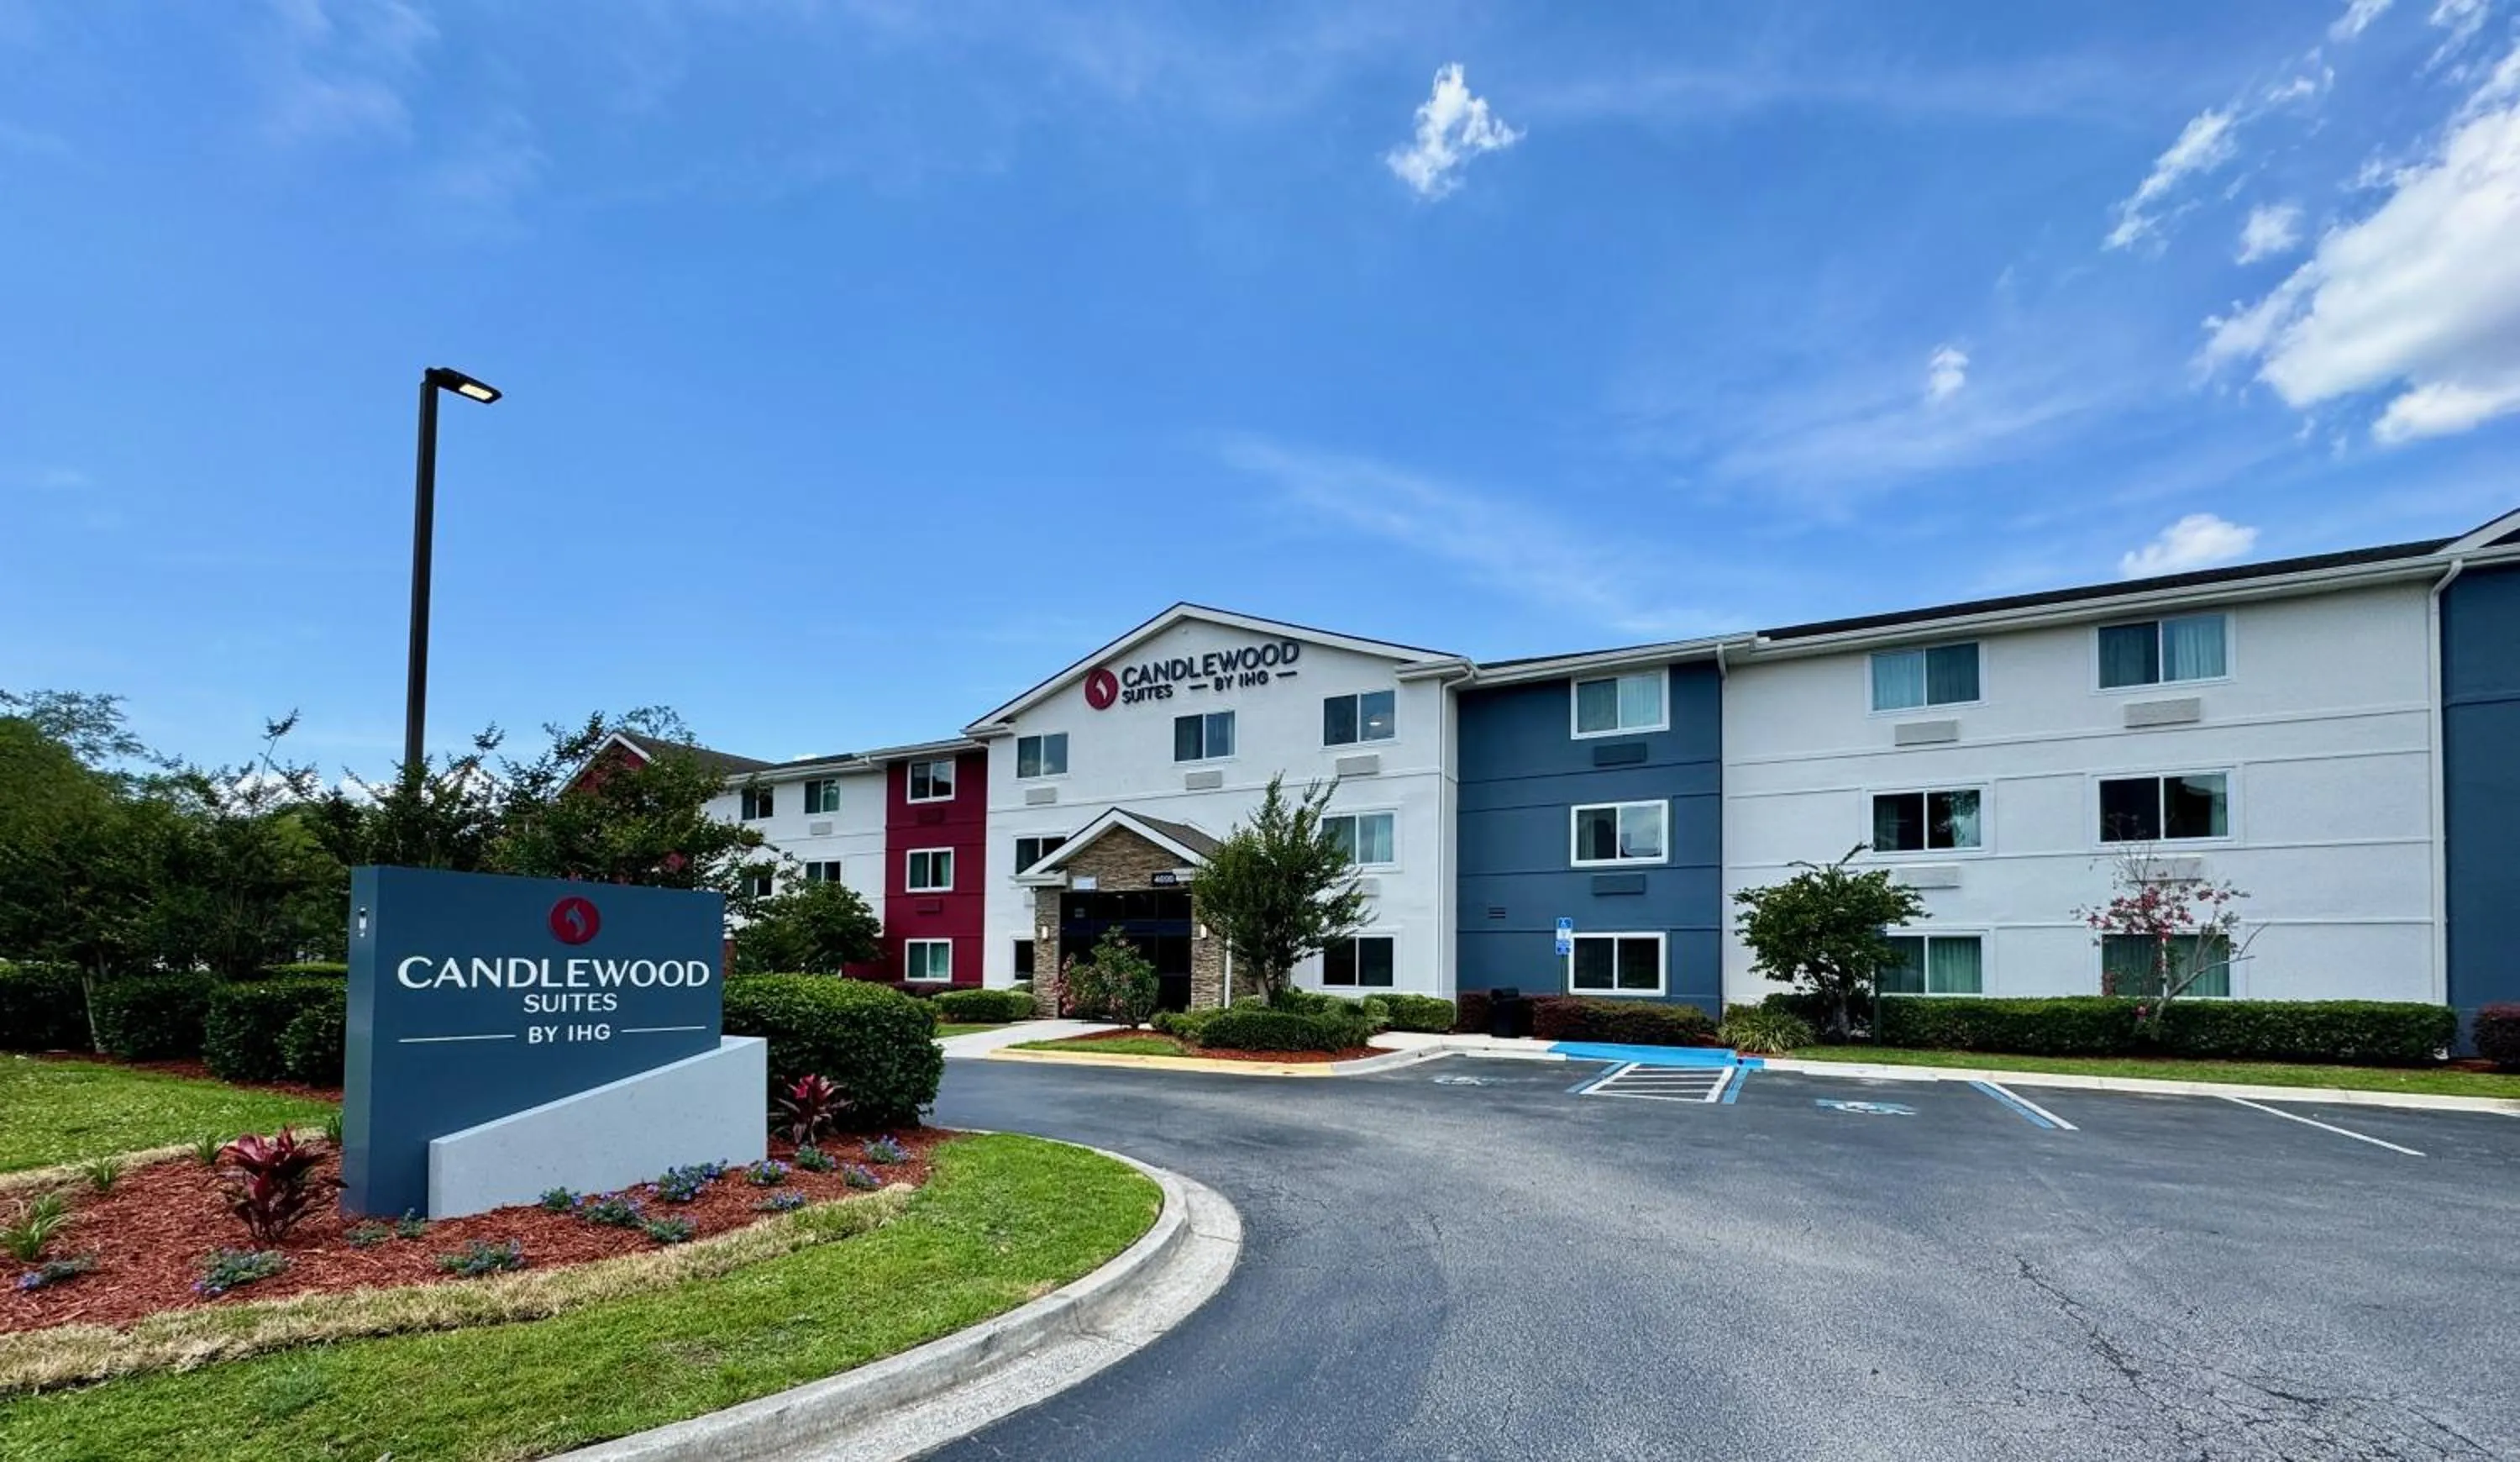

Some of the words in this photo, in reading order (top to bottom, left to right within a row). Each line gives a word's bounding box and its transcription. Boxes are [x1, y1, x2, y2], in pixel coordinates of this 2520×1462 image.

[1121, 641, 1300, 688] CANDLEWOOD
[1121, 684, 1173, 704] SUITES
[1214, 675, 1234, 692] BY
[1239, 670, 1269, 688] IHG
[397, 955, 710, 989] CANDLEWOOD
[523, 993, 618, 1013] SUITES
[528, 1025, 559, 1044] BY
[568, 1023, 612, 1042] IHG
